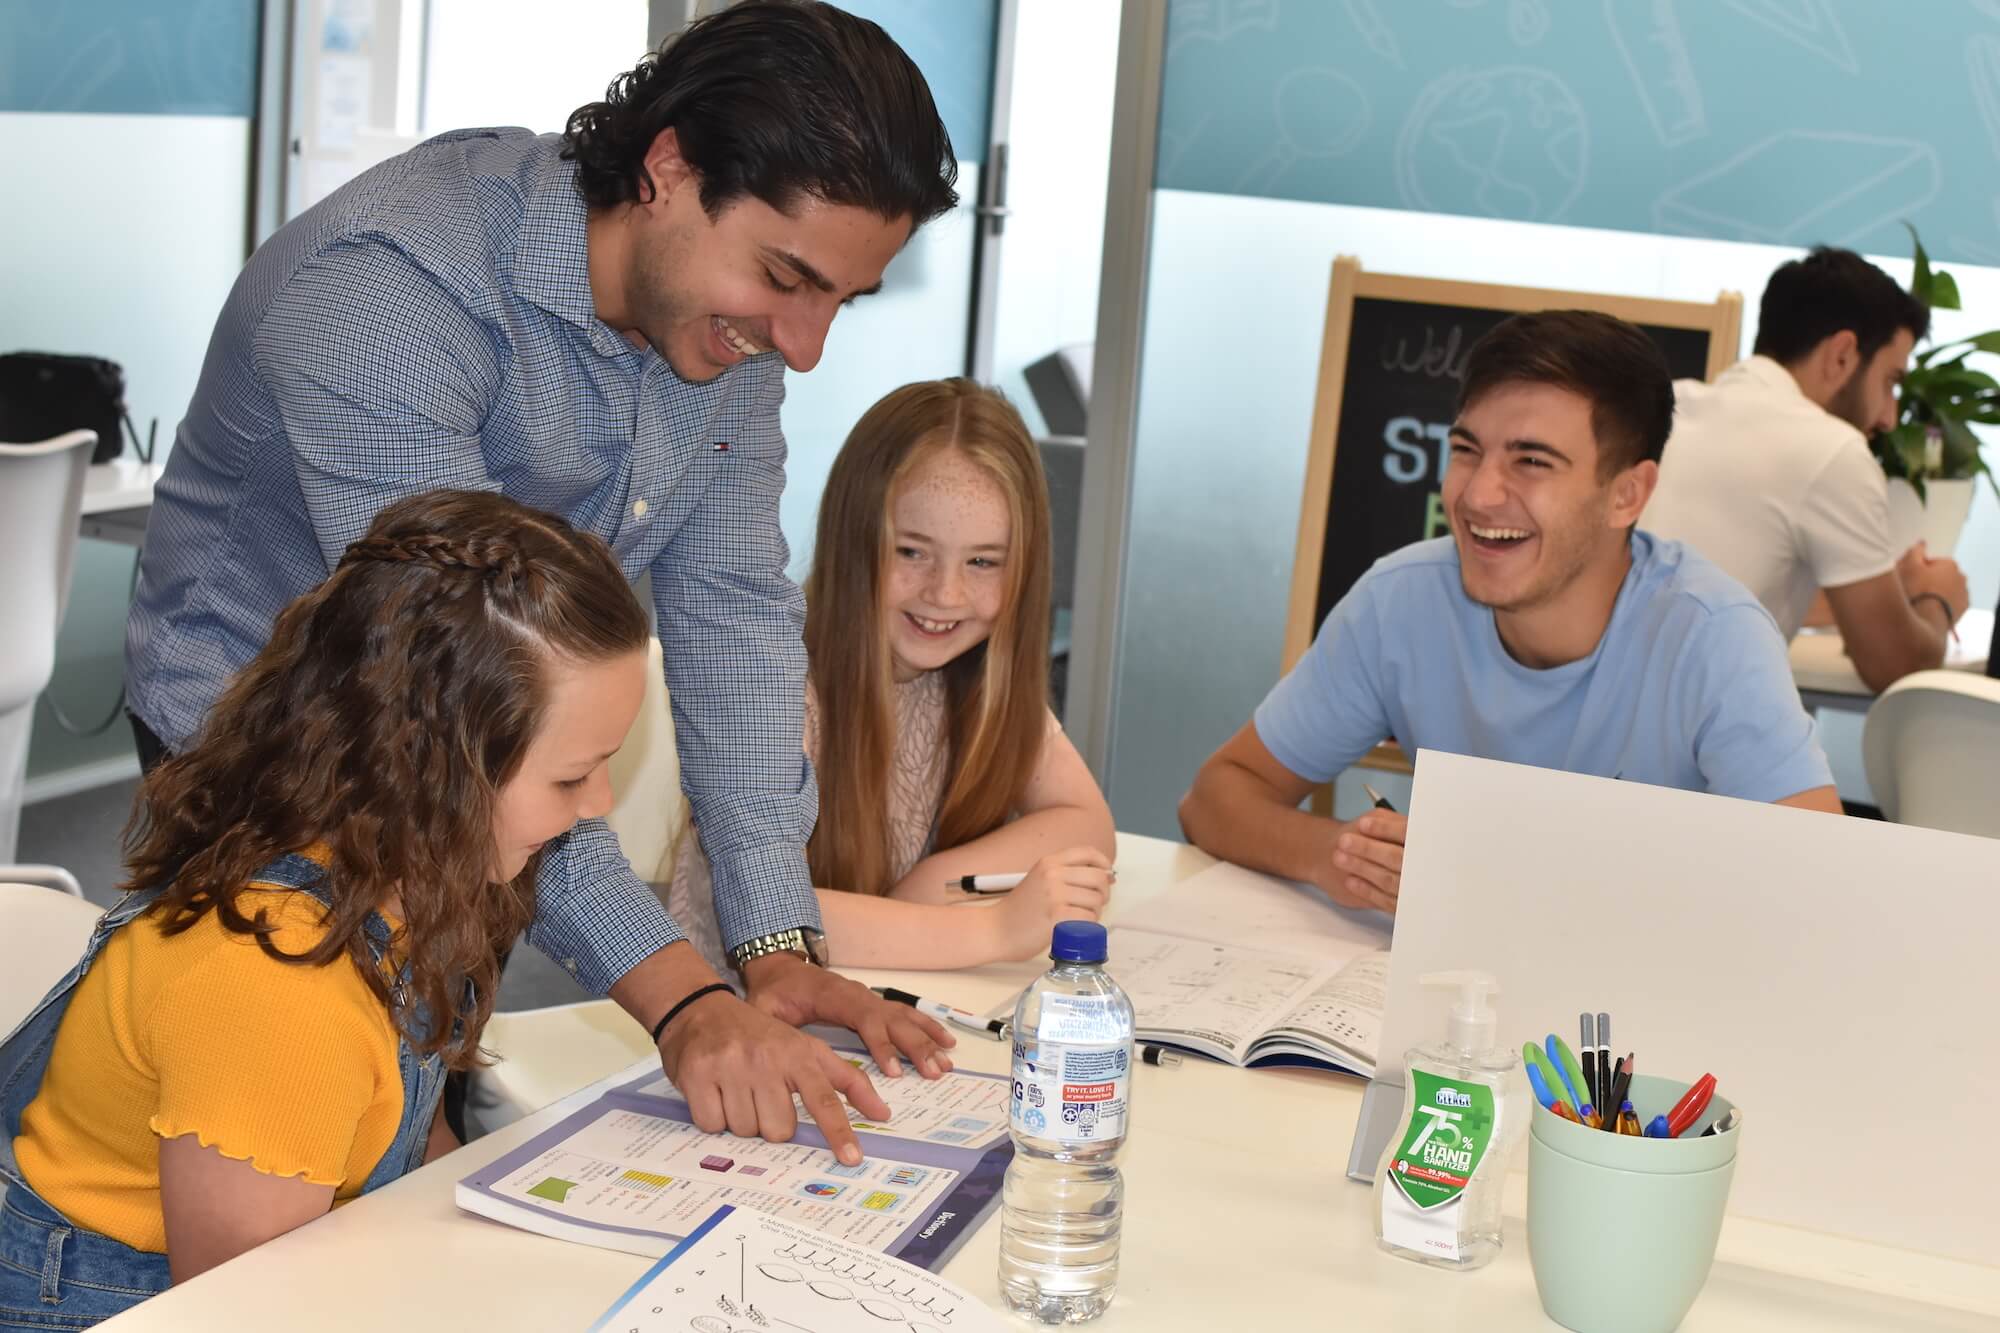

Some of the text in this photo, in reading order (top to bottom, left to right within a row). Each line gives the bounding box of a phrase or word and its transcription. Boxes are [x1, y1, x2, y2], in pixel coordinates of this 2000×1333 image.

[1382, 415, 1453, 485] ST
[1423, 1143, 1473, 1165] HAND
[1423, 1155, 1470, 1172] SANITIZER
[1427, 1168, 1452, 1179] 99.99%
[918, 1211, 957, 1240] Dictionary
[735, 1234, 746, 1242] 2
[882, 1259, 921, 1278] numeral
[921, 1276, 941, 1288] and
